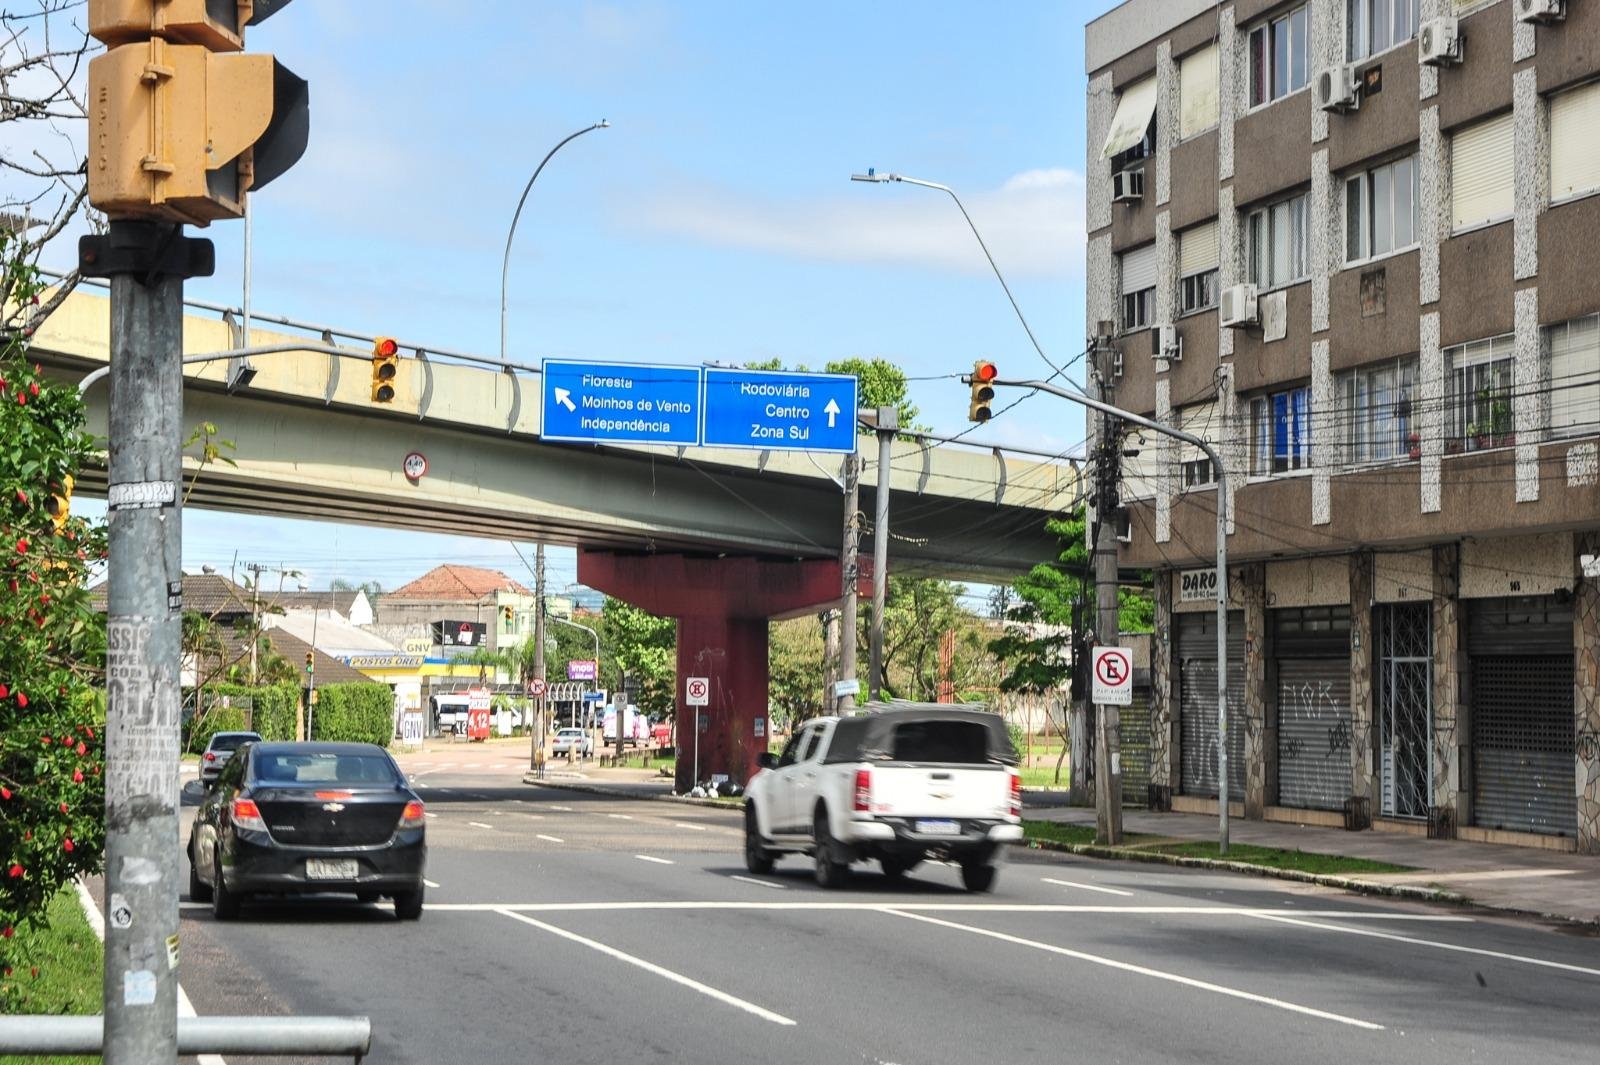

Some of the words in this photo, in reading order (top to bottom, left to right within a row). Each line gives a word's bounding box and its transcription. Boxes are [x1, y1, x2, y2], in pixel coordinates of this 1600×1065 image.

[582, 374, 633, 390] Floresta
[740, 381, 811, 399] Rodoviária
[582, 395, 634, 411] Moinhos
[636, 399, 653, 412] de
[655, 400, 692, 414] Vento
[765, 403, 811, 419] Centro
[580, 416, 671, 434] Independência
[750, 424, 785, 439] Zona
[789, 425, 810, 440] Sul
[406, 642, 430, 653] GNV
[352, 656, 392, 666] POSTOS
[395, 656, 421, 666] OREL
[404, 720, 423, 739] GNV
